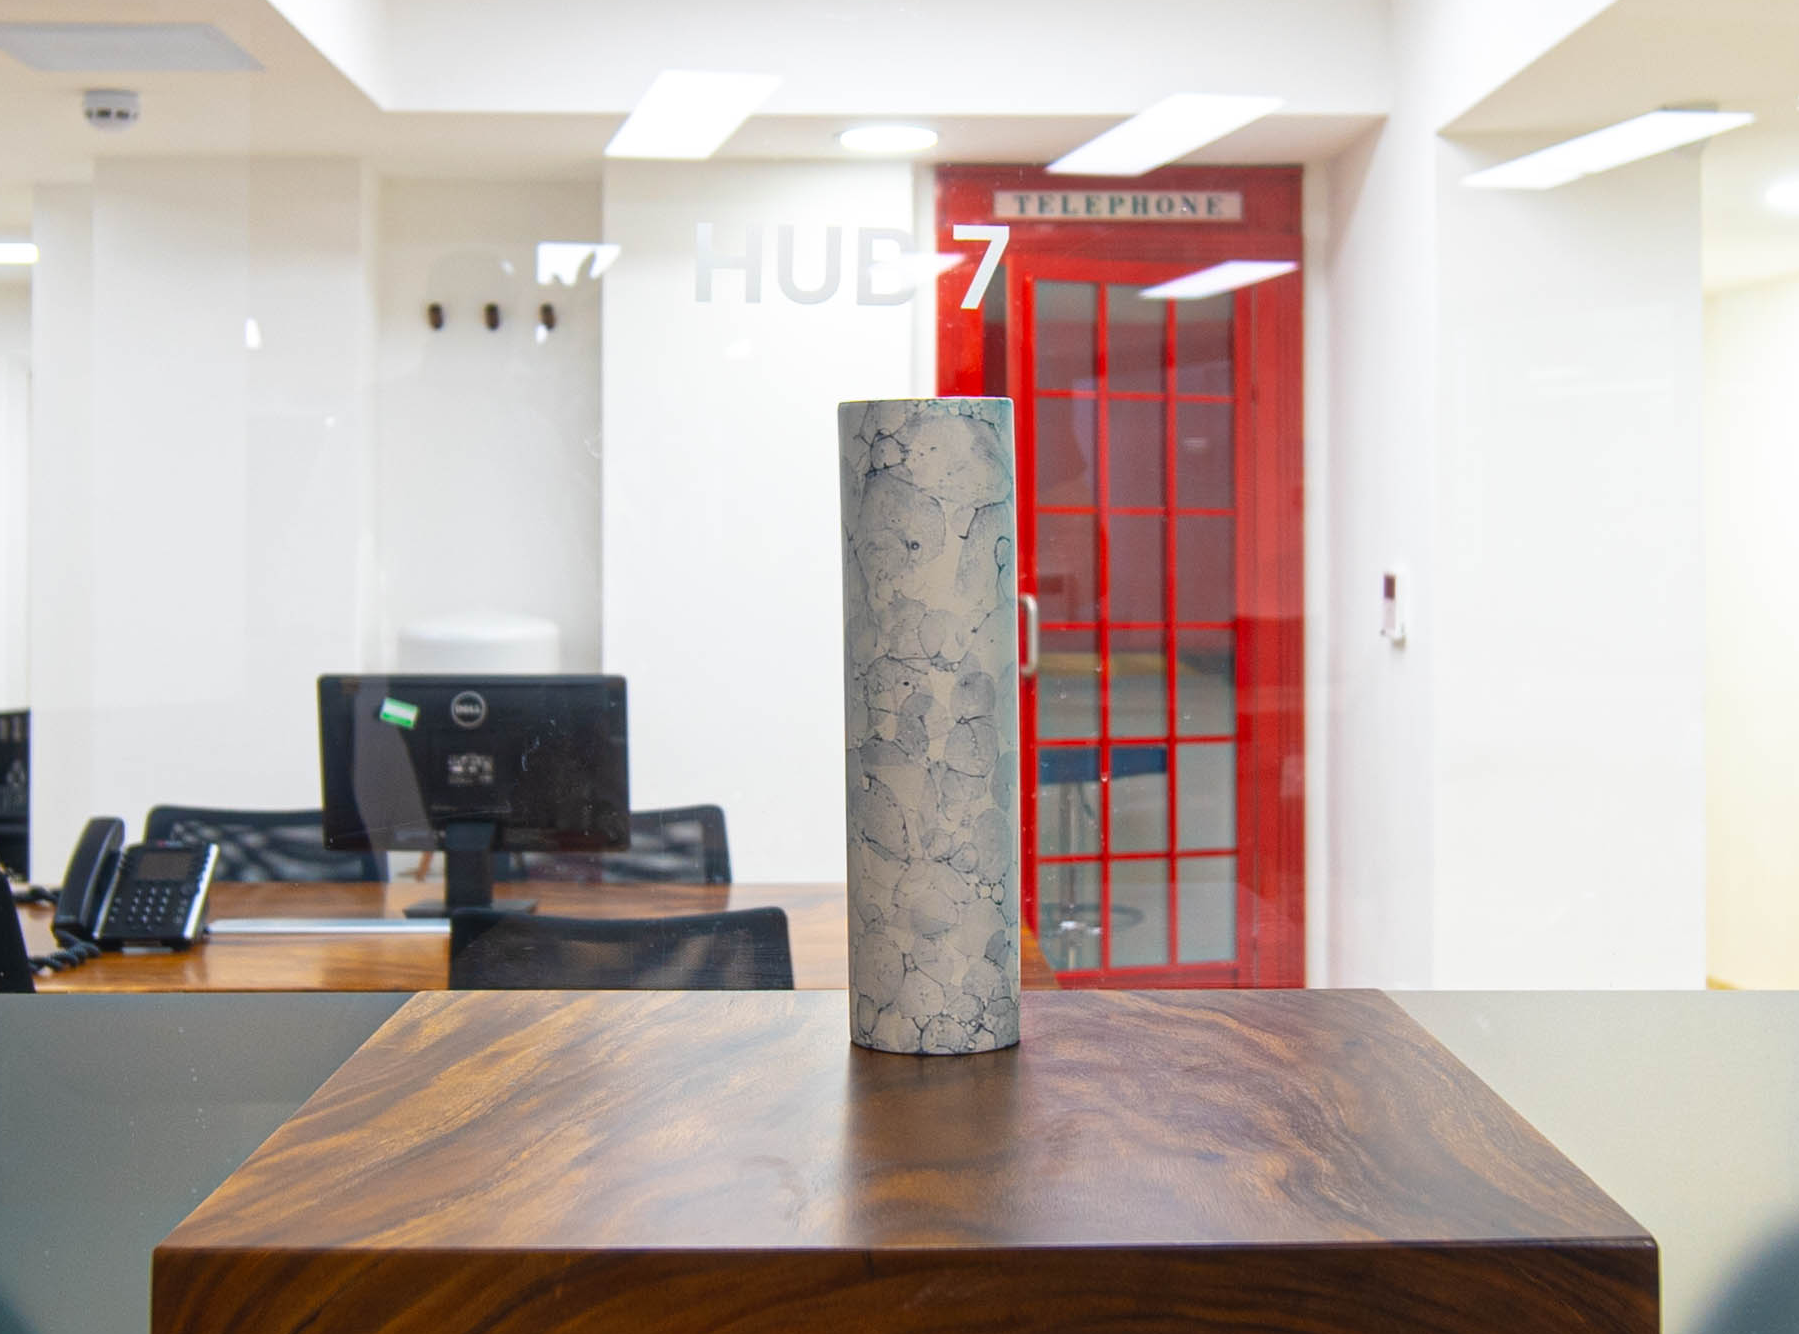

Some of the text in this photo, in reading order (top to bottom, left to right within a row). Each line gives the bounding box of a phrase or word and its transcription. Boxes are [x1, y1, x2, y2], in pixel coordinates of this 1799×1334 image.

[1013, 193, 1224, 216] TELEPHONE
[694, 222, 1010, 310] HUB 7
